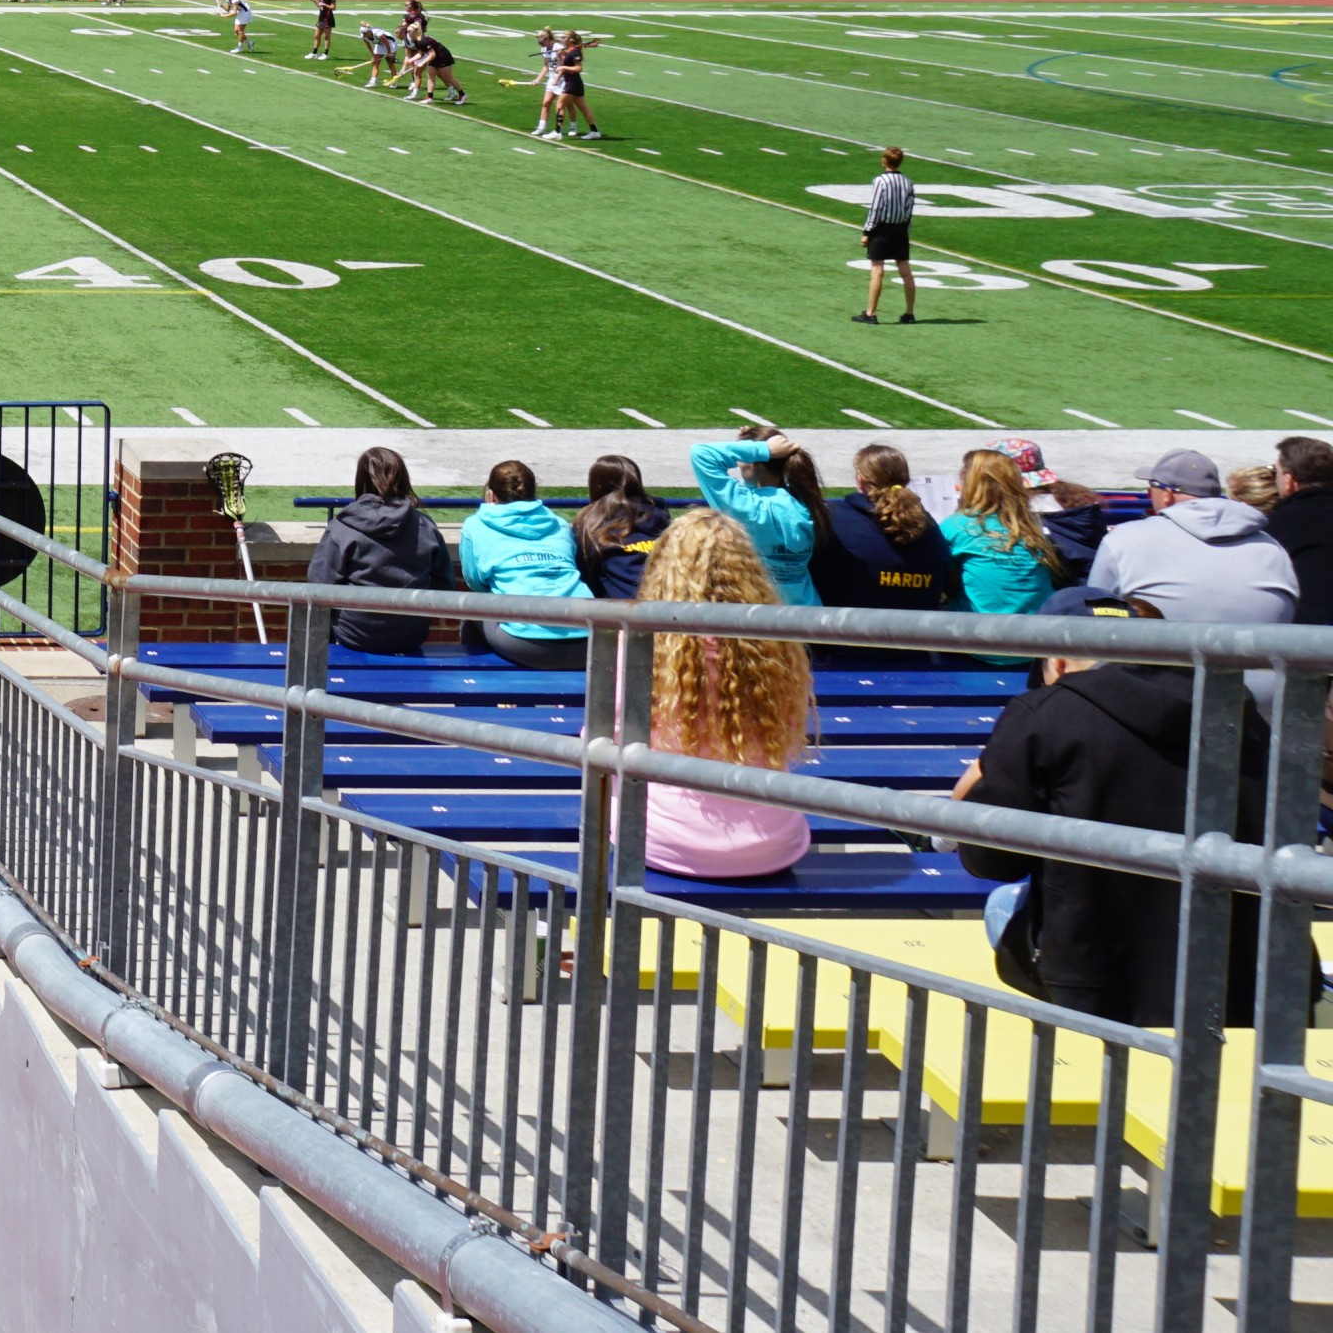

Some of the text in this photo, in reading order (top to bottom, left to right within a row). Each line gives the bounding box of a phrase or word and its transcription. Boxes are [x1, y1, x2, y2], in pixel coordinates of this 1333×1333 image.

[14, 255, 341, 289] 40
[879, 571, 932, 588] HARDY
[903, 939, 925, 948] 20
